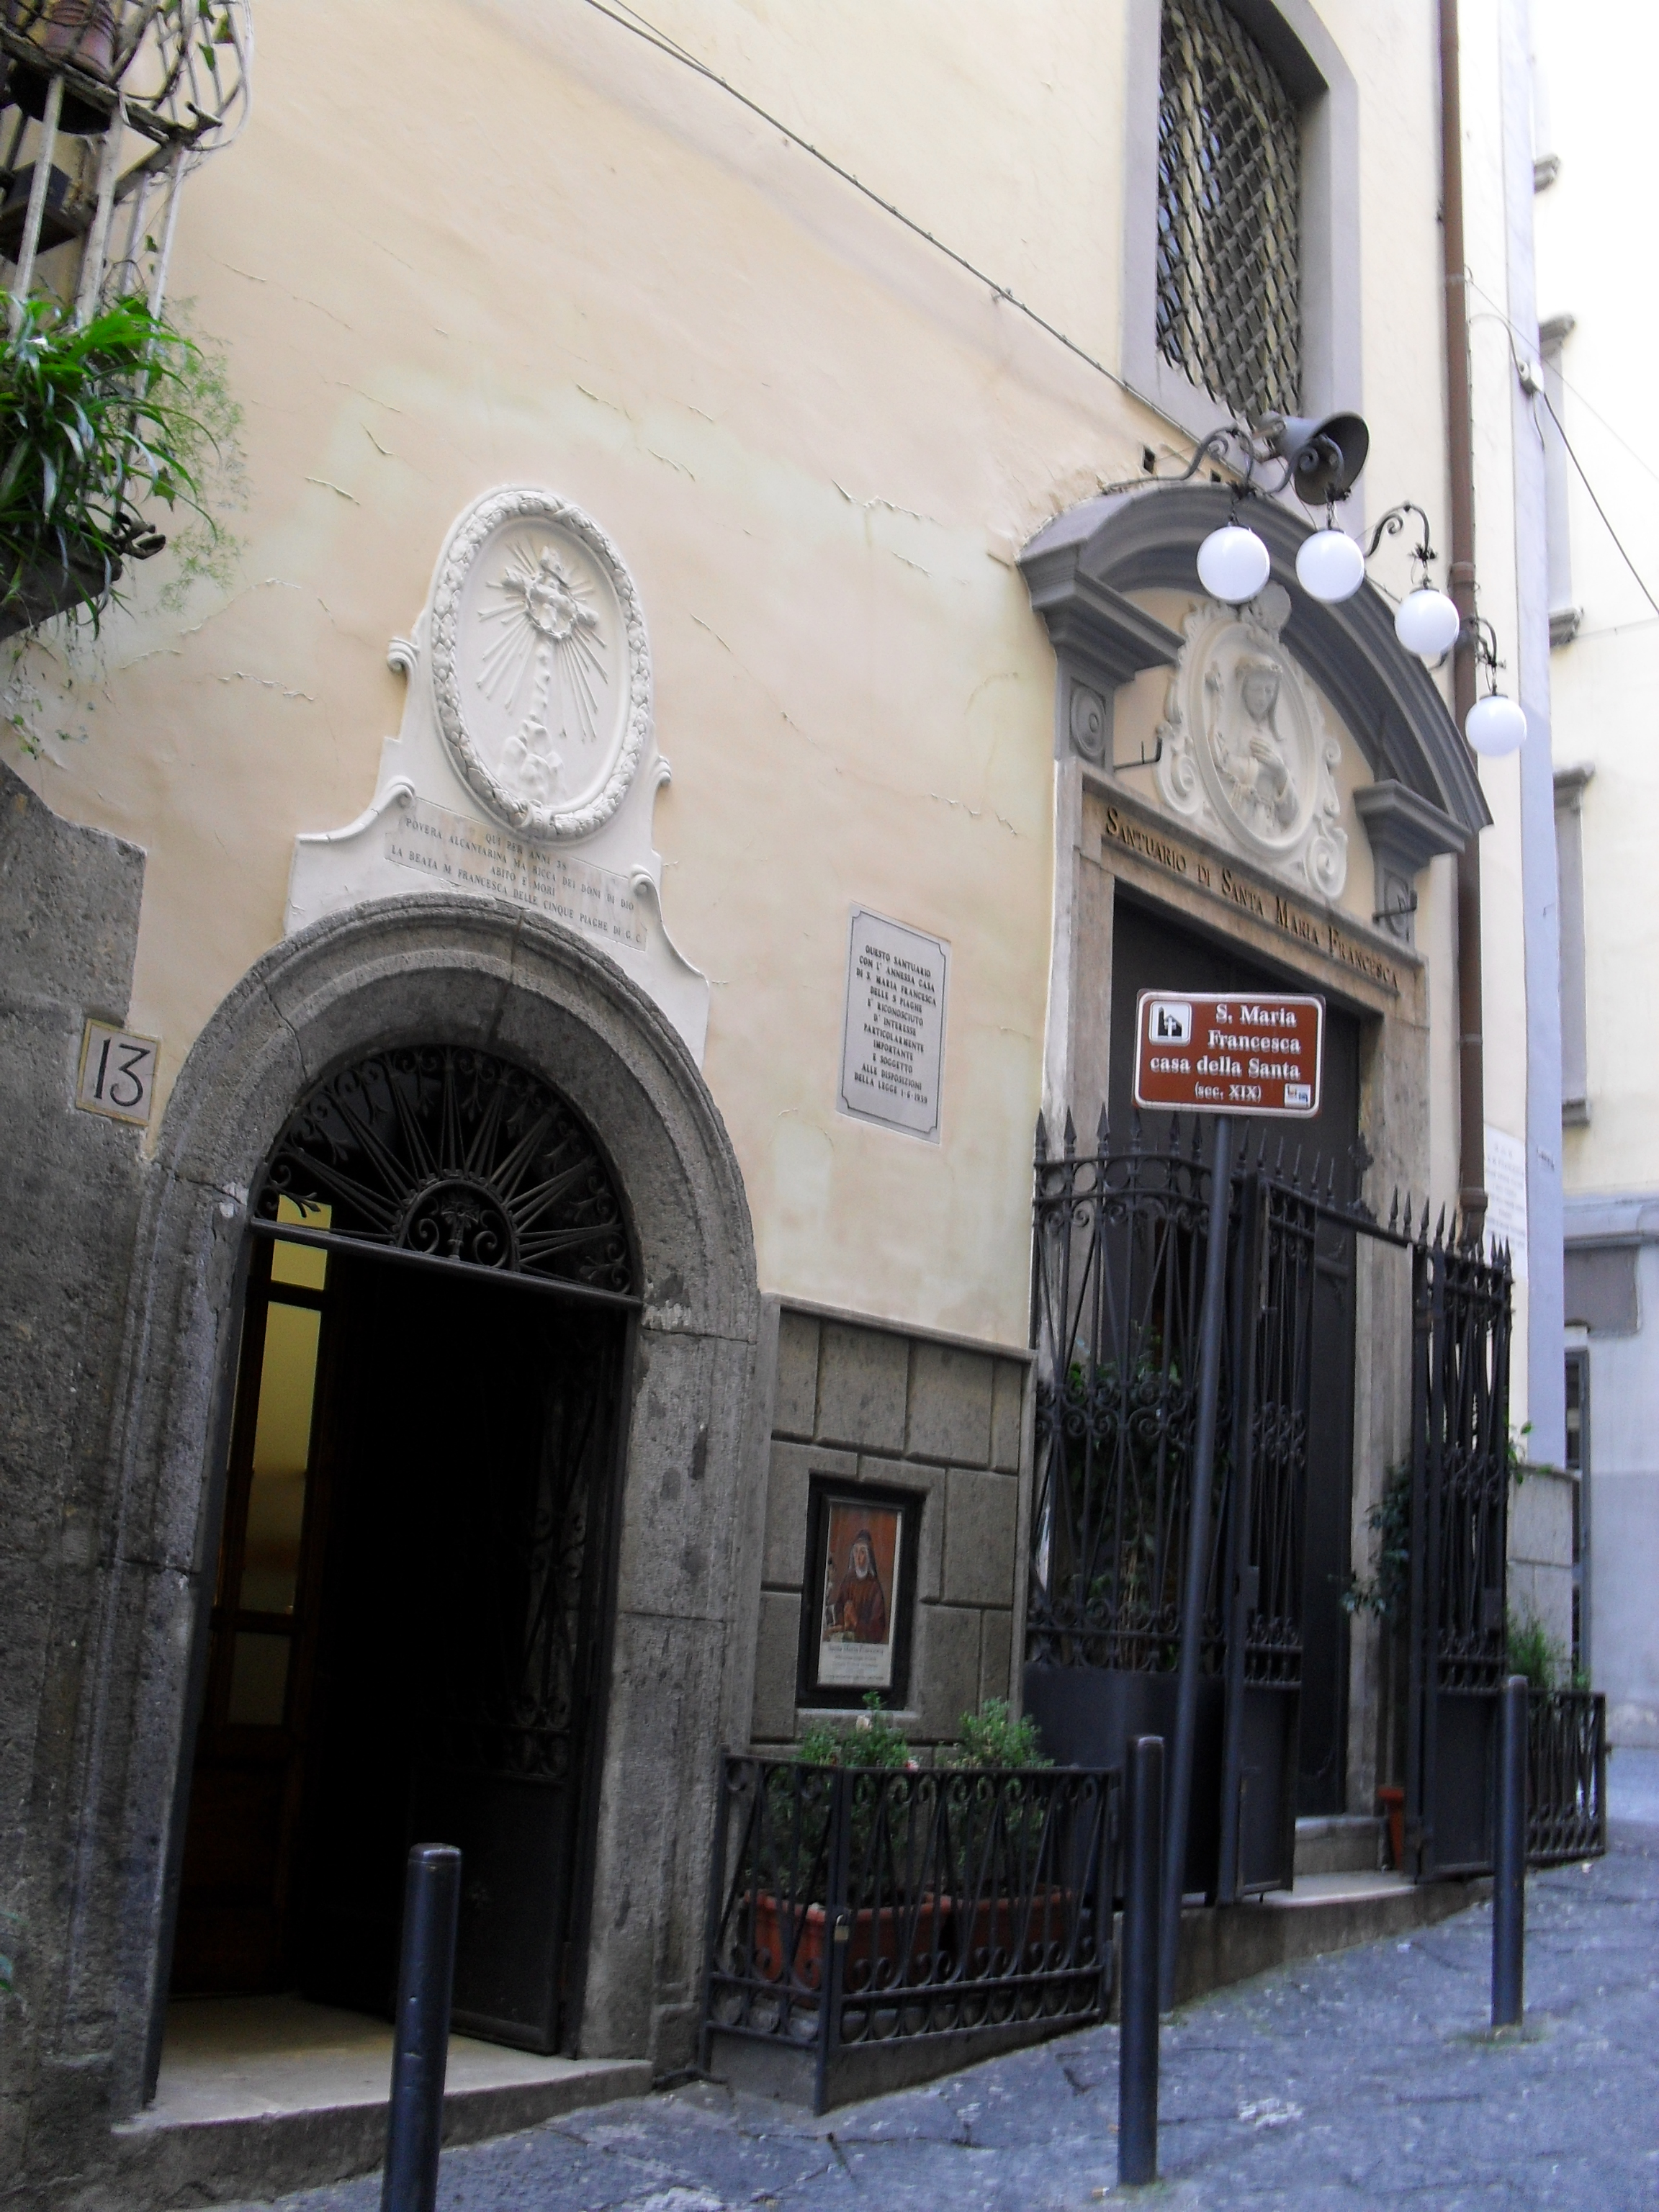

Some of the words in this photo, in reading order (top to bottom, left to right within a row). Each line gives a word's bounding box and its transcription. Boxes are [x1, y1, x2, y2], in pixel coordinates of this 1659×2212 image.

[485, 833, 500, 845] QUI
[507, 840, 523, 854] PER
[530, 850, 550, 865] ANNI
[405, 817, 442, 839] POVERA
[449, 835, 507, 863] ALCANTARINA
[513, 858, 526, 871] MA
[532, 866, 556, 881] RICCA
[562, 876, 575, 889] DEI
[581, 884, 601, 899] DONI
[607, 894, 615, 904] DI
[621, 899, 634, 910] DIO
[391, 845, 403, 858] LA
[409, 850, 438, 870] BEATA
[457, 868, 508, 896] FRANCESCA
[513, 889, 538, 905] DELLE
[544, 900, 574, 919] CINQUE
[580, 913, 608, 931] PIAGHE
[613, 925, 621, 935] DI
[522, 876, 527, 886] E
[859, 956, 873, 968] CON
[886, 966, 915, 985] ANNESSA
[919, 979, 935, 992] CASA
[866, 945, 890, 961] QUESTO
[894, 956, 931, 978] SANTUARIO
[856, 967, 863, 978] DI
[876, 976, 896, 991] MARIA
[901, 985, 936, 1006] FRANCESCA
[870, 986, 888, 1000] DELLE
[899, 997, 922, 1013] PIAGHE
[877, 1002, 924, 1027] RICONOSCIUTO
[884, 1017, 916, 1036] INTERESSE
[1215, 1003, 1233, 1024] S.
[1239, 1005, 1297, 1028] Maria
[864, 1023, 924, 1053] PARTICOLARMENTE
[873, 1039, 913, 1061] IMPORTANTE
[1208, 1030, 1301, 1054] Francesca
[94, 1036, 150, 1107] 13
[873, 1053, 876, 1061] E
[880, 1055, 913, 1074] SOGGETTO
[1150, 1057, 1191, 1073] casa
[1196, 1055, 1243, 1078] della
[1248, 1057, 1301, 1080] Santa
[854, 1072, 874, 1087] DELLA
[878, 1080, 897, 1094] LEGGE
[862, 1063, 877, 1075] ALLE
[881, 1069, 922, 1091] DISPOSIZIONI
[1228, 1084, 1262, 1104] XIX)
